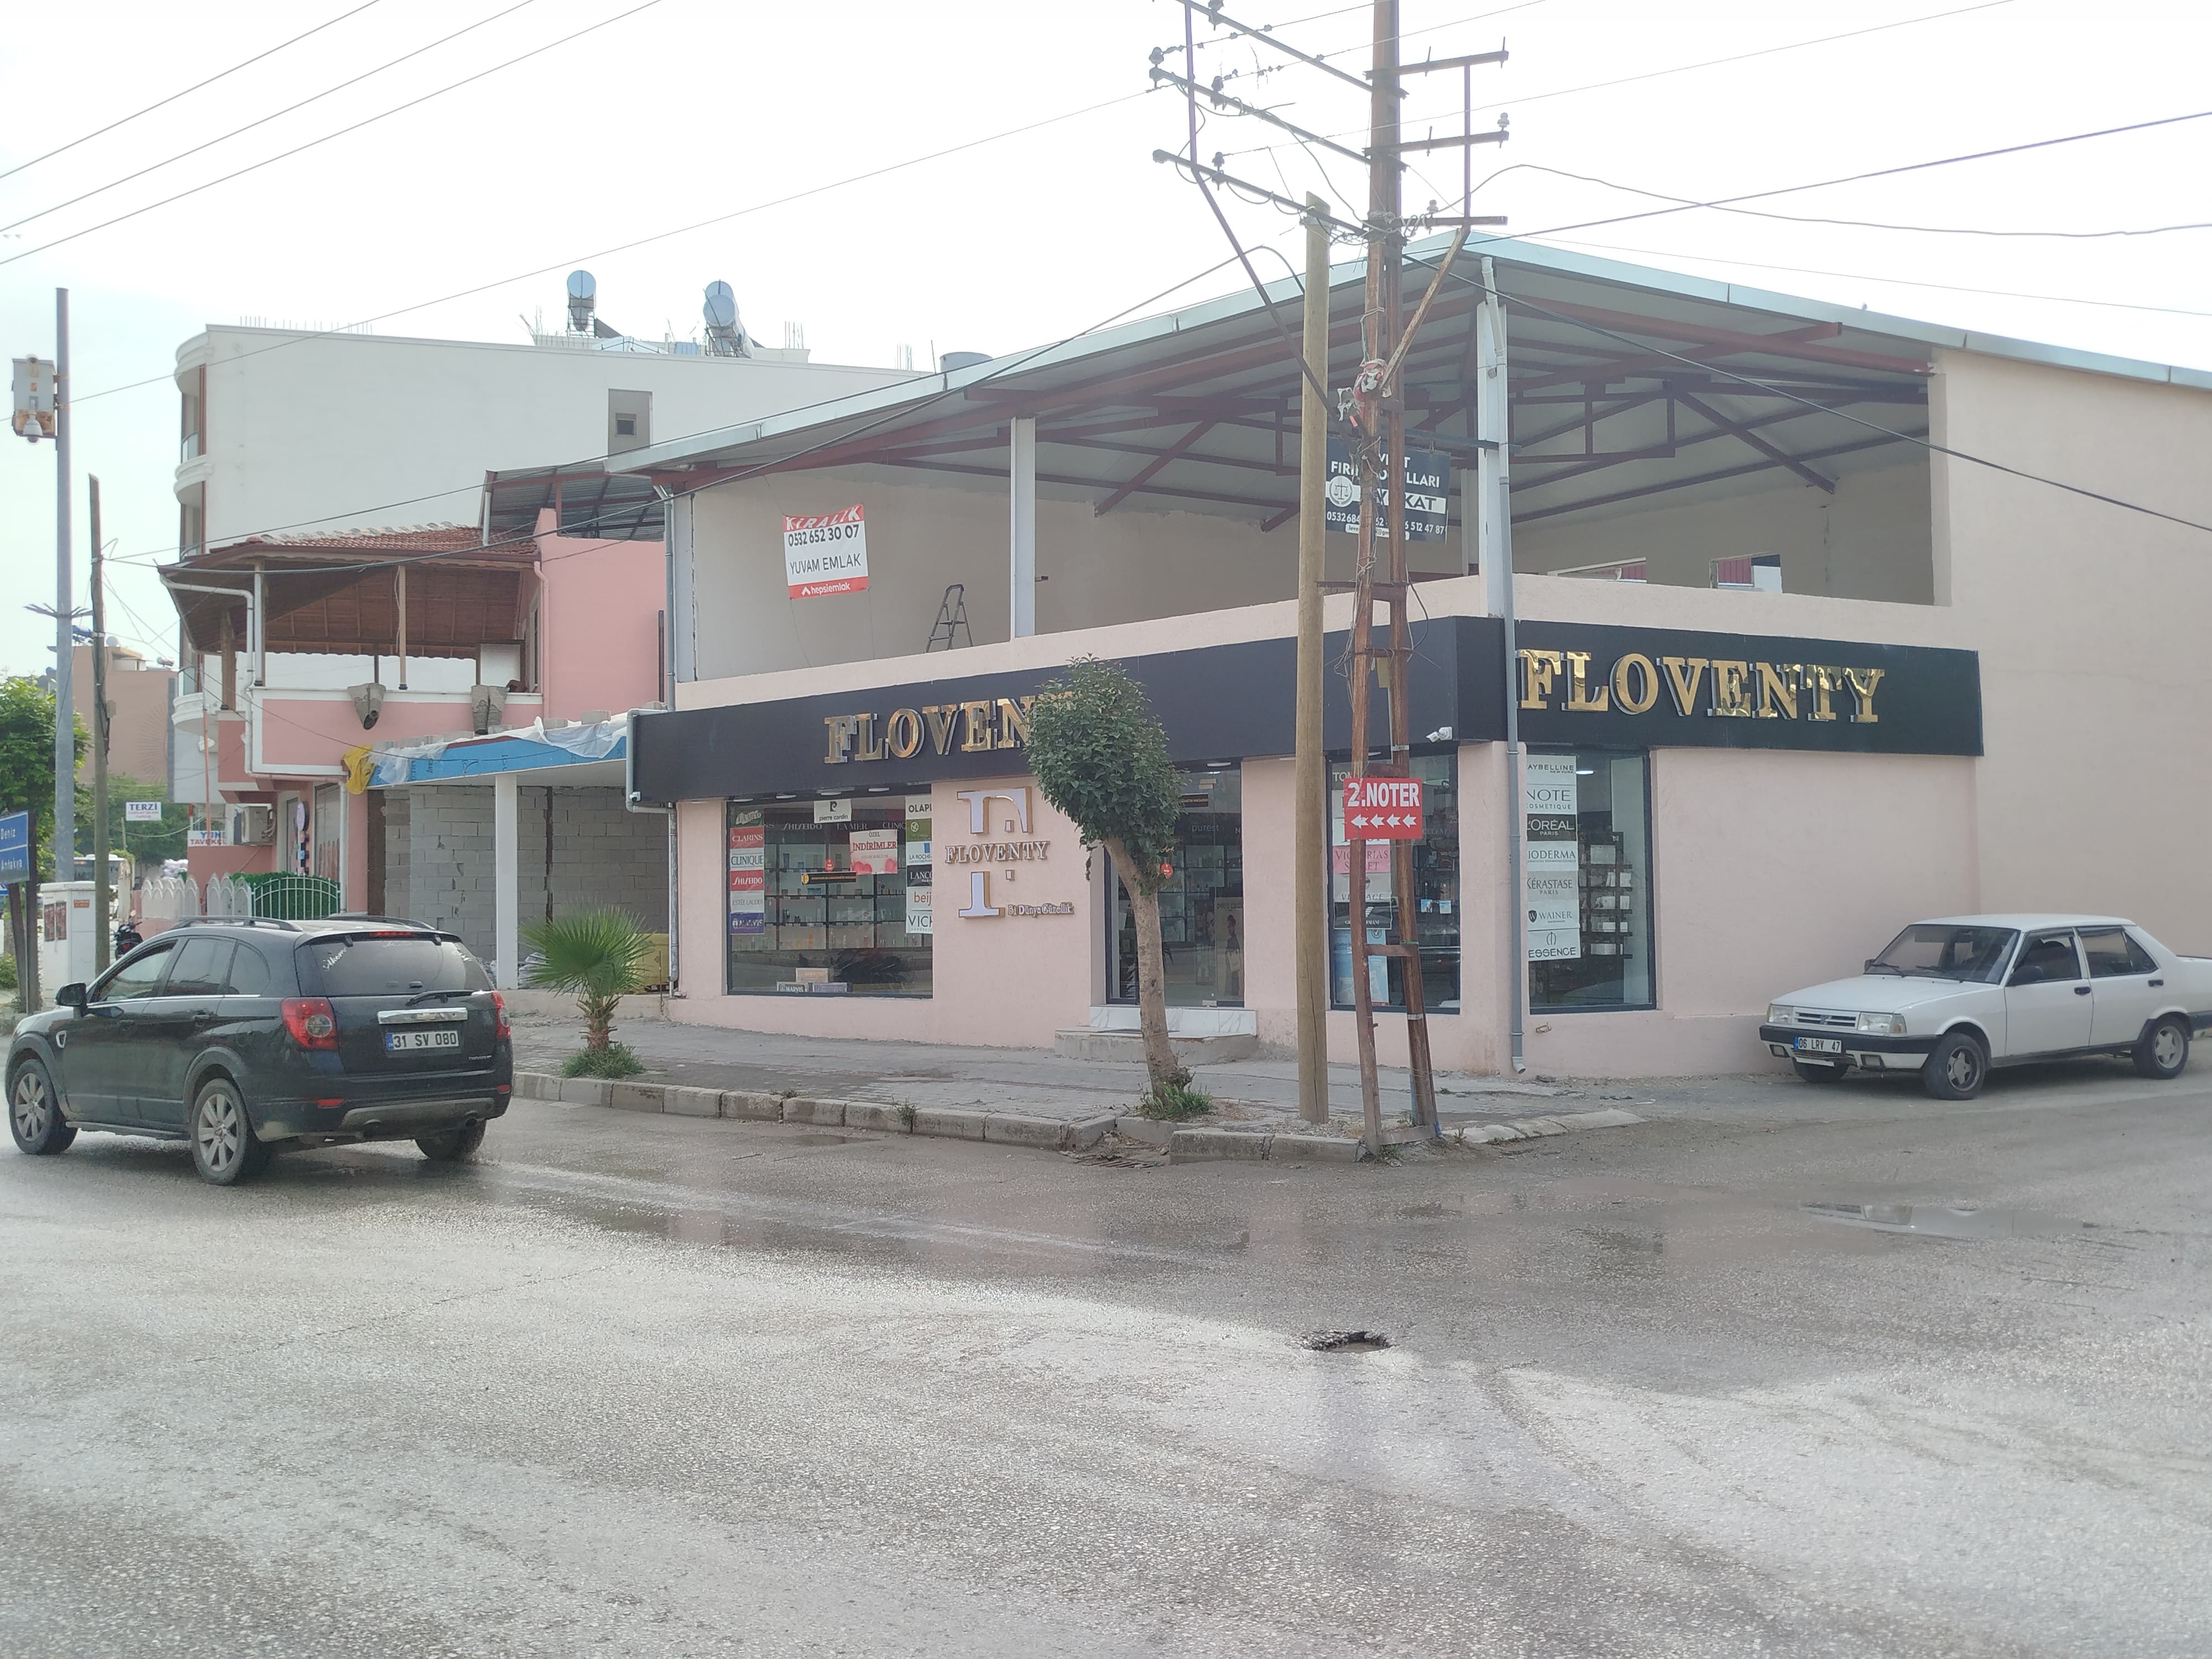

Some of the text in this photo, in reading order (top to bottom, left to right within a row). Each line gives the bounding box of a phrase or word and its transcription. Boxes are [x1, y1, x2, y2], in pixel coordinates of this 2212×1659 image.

[1327, 512, 1346, 522] 0532
[1424, 524, 1433, 533] 47
[1435, 525, 1444, 534] 87
[788, 524, 859, 547] 0532 652 30 07
[790, 553, 861, 575] YUVAM EMLAK
[811, 582, 851, 595] hepsiemlak
[1517, 649, 1885, 723] FLOVENTY
[824, 691, 1073, 764] FLOVEN
[1347, 782, 1420, 807] 2.NOTER
[1527, 790, 1571, 801] NOTE
[1, 827, 16, 840] Deniz
[853, 841, 897, 851] İNDİRİMLER
[945, 841, 1050, 864] FLOVENTY
[731, 855, 763, 865] CLINIQUE
[1336, 850, 1389, 859] VICRIAS
[1528, 850, 1575, 859] IODERMA
[1, 857, 23, 872] Antakya
[732, 877, 763, 885] SHISEIDO
[914, 891, 932, 906] beij
[1018, 904, 1041, 918] Dünya
[1041, 902, 1074, 915] Güzellik
[908, 915, 932, 927] VICH
[1528, 947, 1576, 958] ESSENCE
[394, 1032, 457, 1048] 31 SV 080
[1799, 1039, 1807, 1048] 06
[1832, 1041, 1840, 1052] 47
